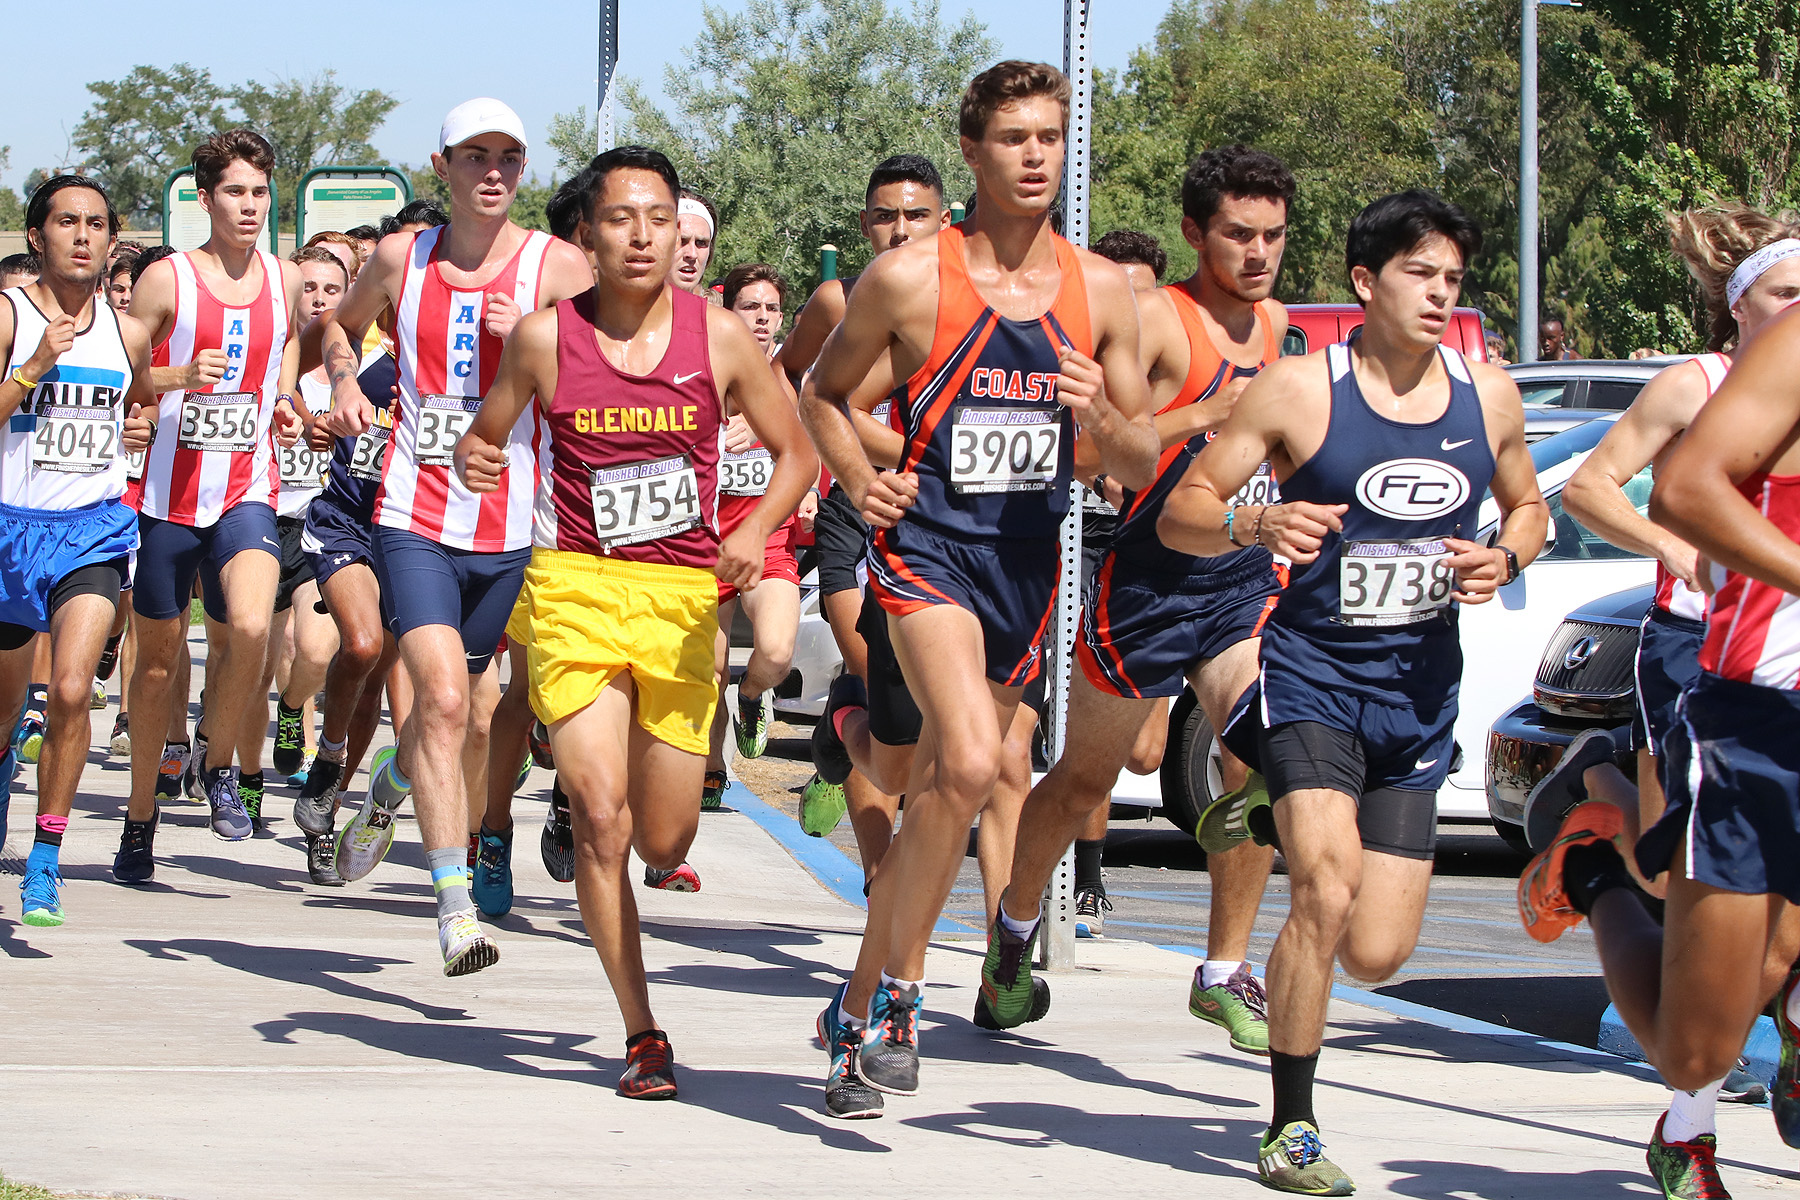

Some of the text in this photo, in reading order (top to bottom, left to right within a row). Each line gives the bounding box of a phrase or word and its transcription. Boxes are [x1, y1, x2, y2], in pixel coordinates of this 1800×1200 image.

[189, 392, 253, 405] FINISHED RESULTS
[971, 367, 1060, 402] COAST
[42, 404, 111, 420] FINISHED RESULTS
[425, 395, 465, 410] FINISHED
[959, 408, 1054, 425] FINISHED RESULTS
[182, 405, 256, 439] 3556
[574, 405, 698, 433] GLENDALE
[36, 421, 115, 459] 4042
[954, 428, 1057, 475] 3902
[596, 456, 684, 485] FINISHED RESULTS
[721, 460, 771, 489] 358
[963, 482, 1046, 493] WWW.FINISHEDRESULTS.COM
[1378, 475, 1450, 505] FC
[596, 474, 697, 531] 3754
[611, 521, 692, 547] WWW.FINISHEDRESULTS.COM
[1348, 539, 1447, 557] FINISHED RESULTS
[1344, 558, 1450, 608] 3738
[1353, 610, 1438, 627] WWW.FINISHEDRESULTS.COM
